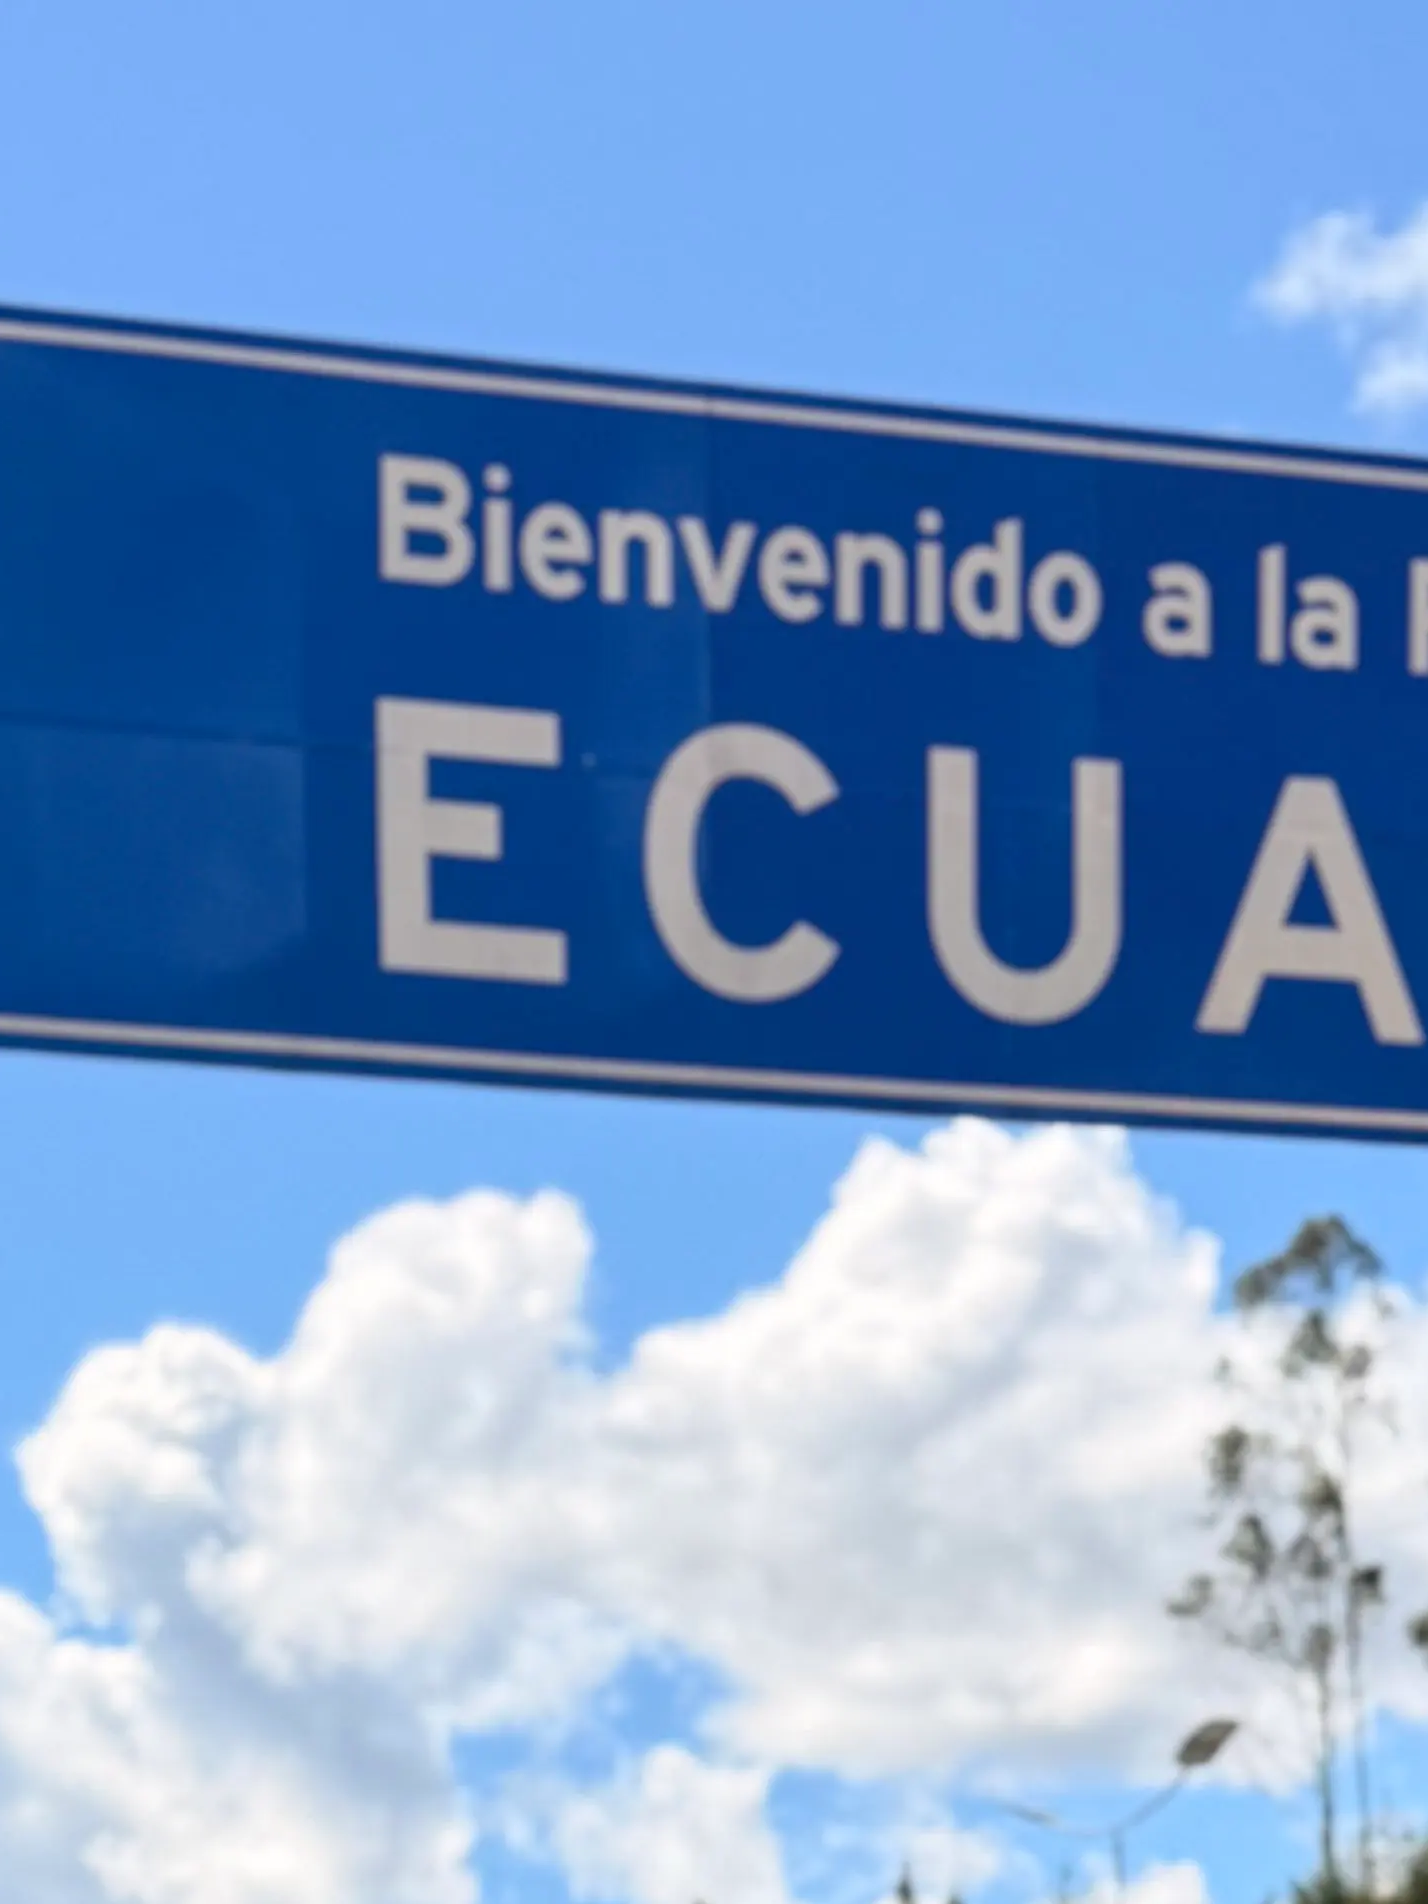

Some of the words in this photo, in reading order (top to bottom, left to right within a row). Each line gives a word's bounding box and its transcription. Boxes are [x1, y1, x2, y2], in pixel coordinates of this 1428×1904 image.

[378, 454, 1103, 648] Bienvenido
[1142, 563, 1212, 658] a
[1257, 545, 1358, 670] la
